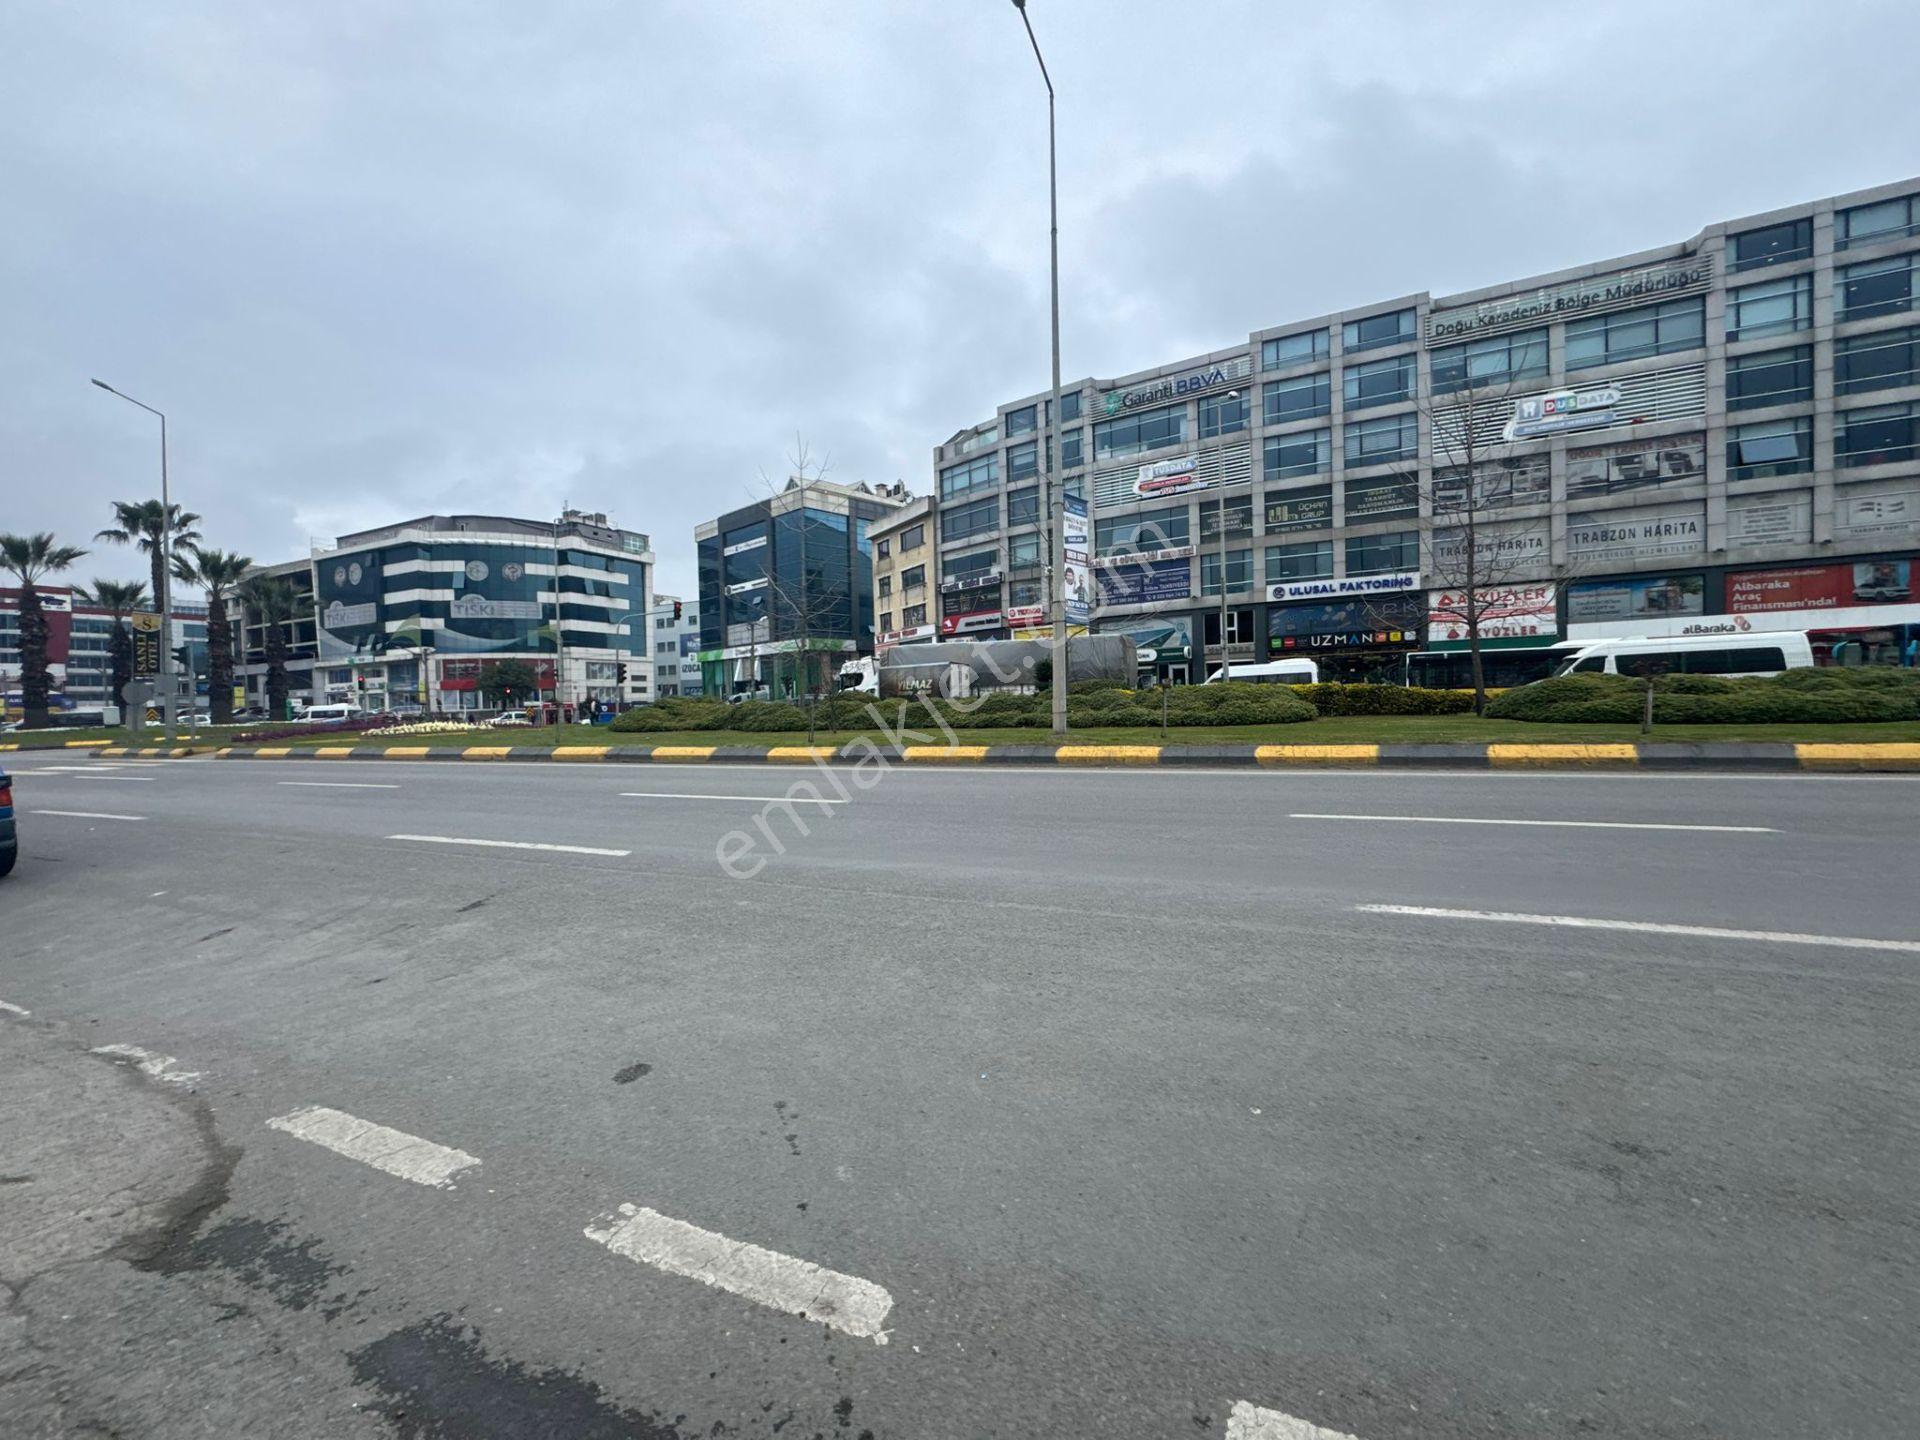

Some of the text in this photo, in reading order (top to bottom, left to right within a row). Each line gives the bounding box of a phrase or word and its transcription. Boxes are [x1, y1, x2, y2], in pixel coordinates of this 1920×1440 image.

[1435, 320, 1473, 336] Doğu
[1478, 302, 1552, 327] Karadeniz
[1555, 293, 1600, 310] Bölge
[1122, 369, 1226, 407] Garanti BBVA
[1573, 527, 1636, 545] TRABZON
[1439, 543, 1493, 557] TRABON
[1289, 583, 1336, 596] ULUSAL
[1733, 580, 1790, 591] Albaraka
[1733, 593, 1762, 602] Araç
[1311, 633, 1374, 646] UZMAN
[898, 679, 933, 690] YILMAZ
